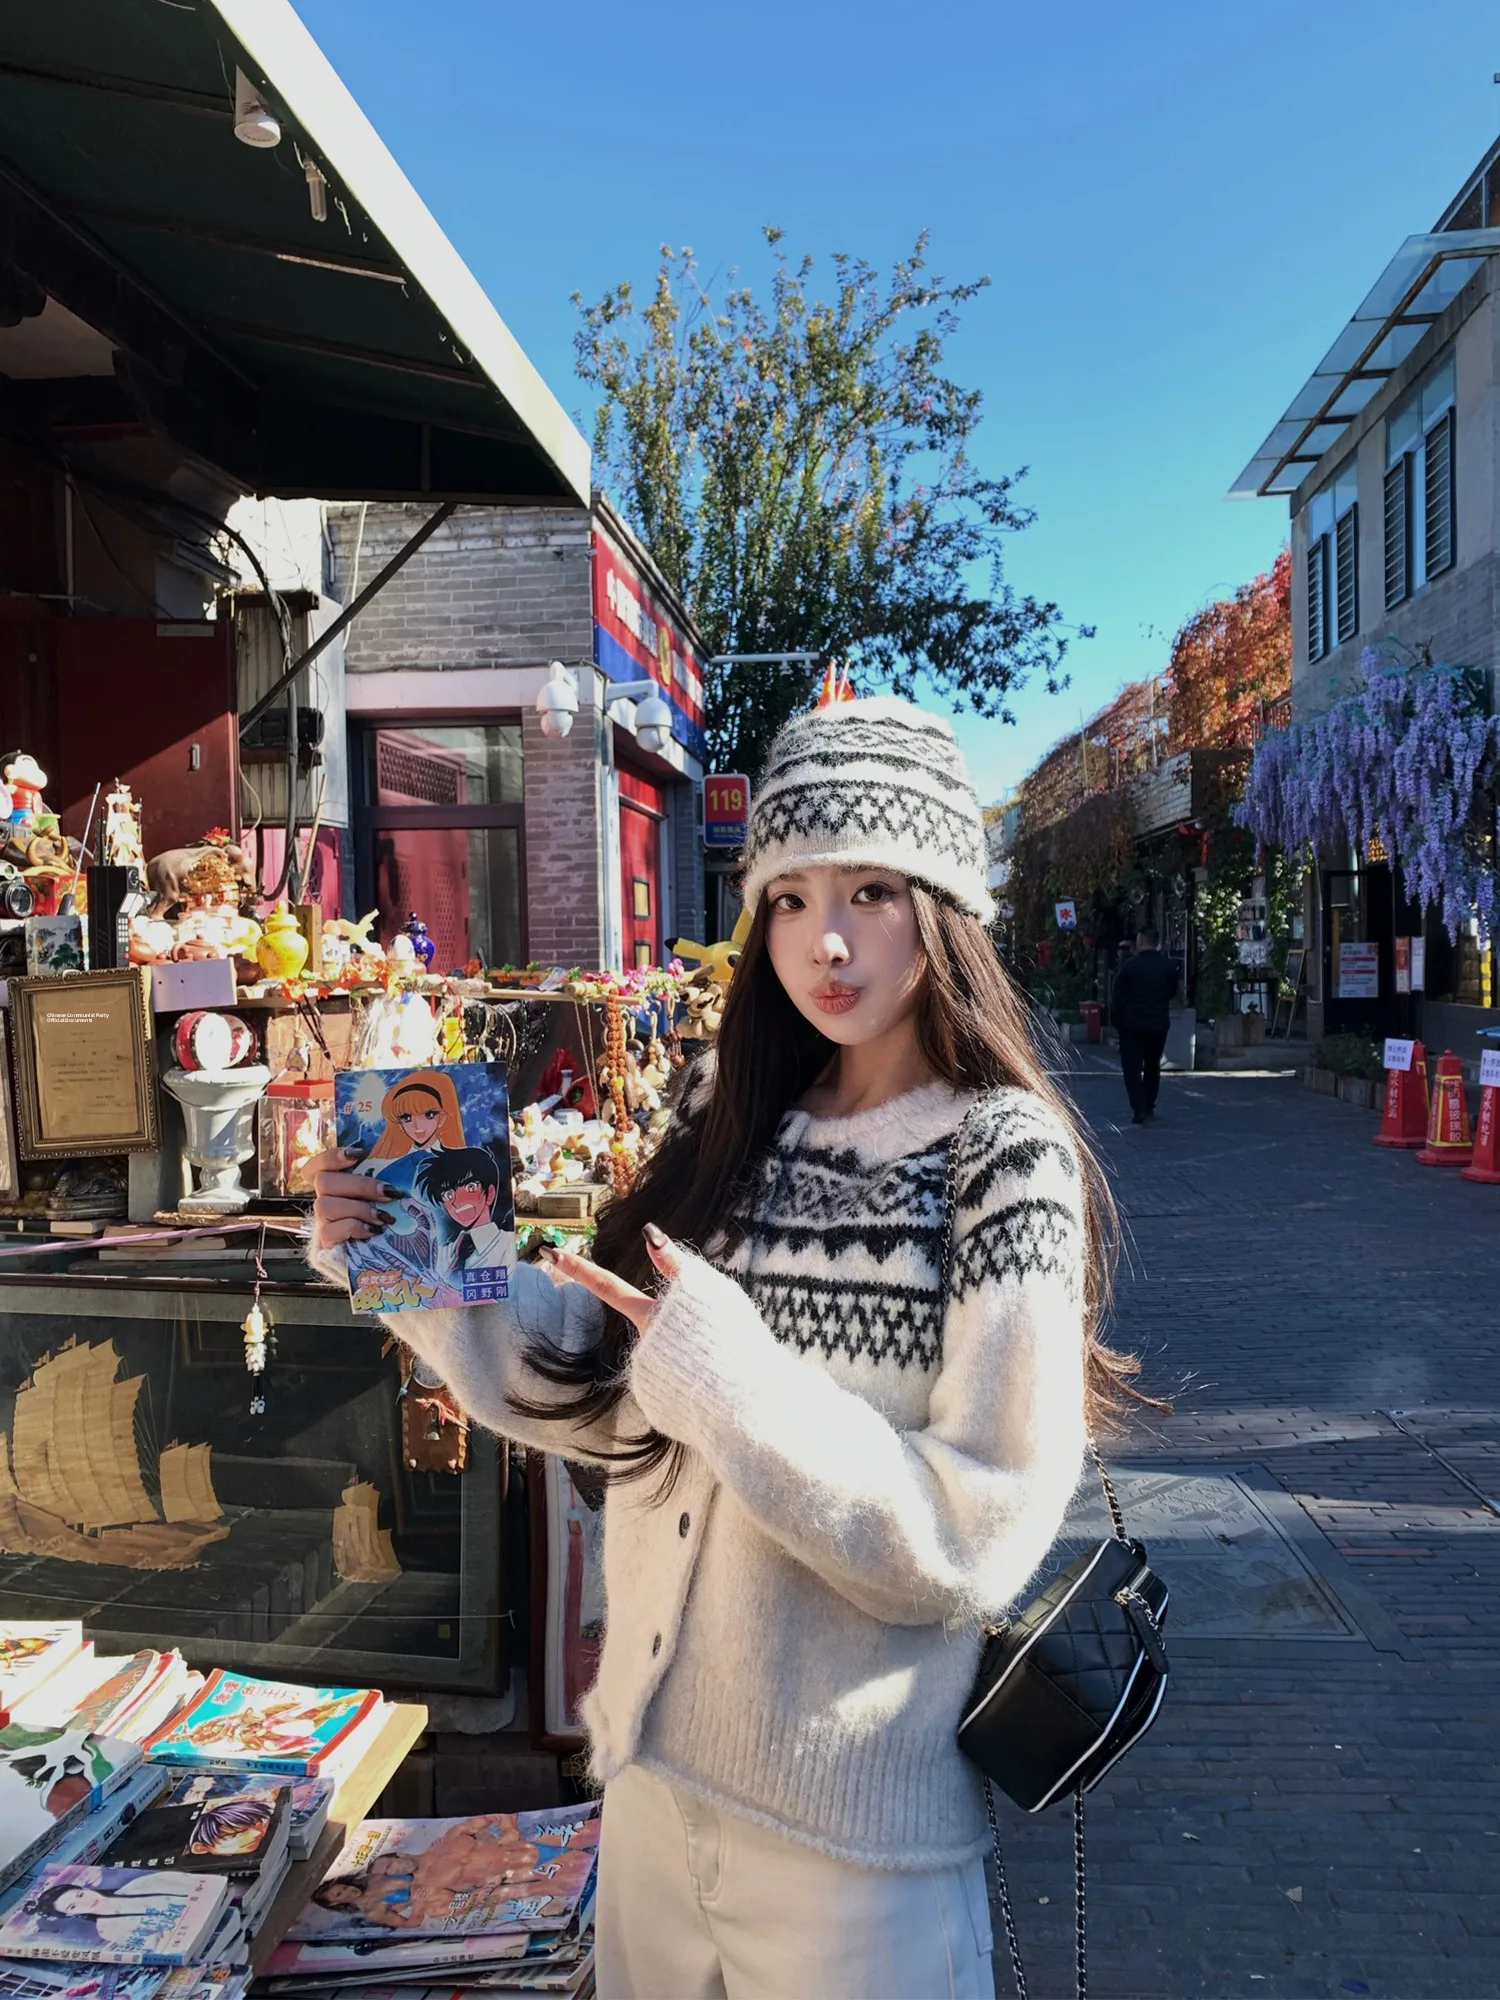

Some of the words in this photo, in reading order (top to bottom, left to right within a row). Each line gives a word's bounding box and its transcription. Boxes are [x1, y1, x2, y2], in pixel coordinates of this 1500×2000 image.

[709, 788, 743, 811] 119
[358, 1101, 372, 1113] 25
[465, 1268, 507, 1284] 真仓翔
[465, 1285, 508, 1301] 冈野刚
